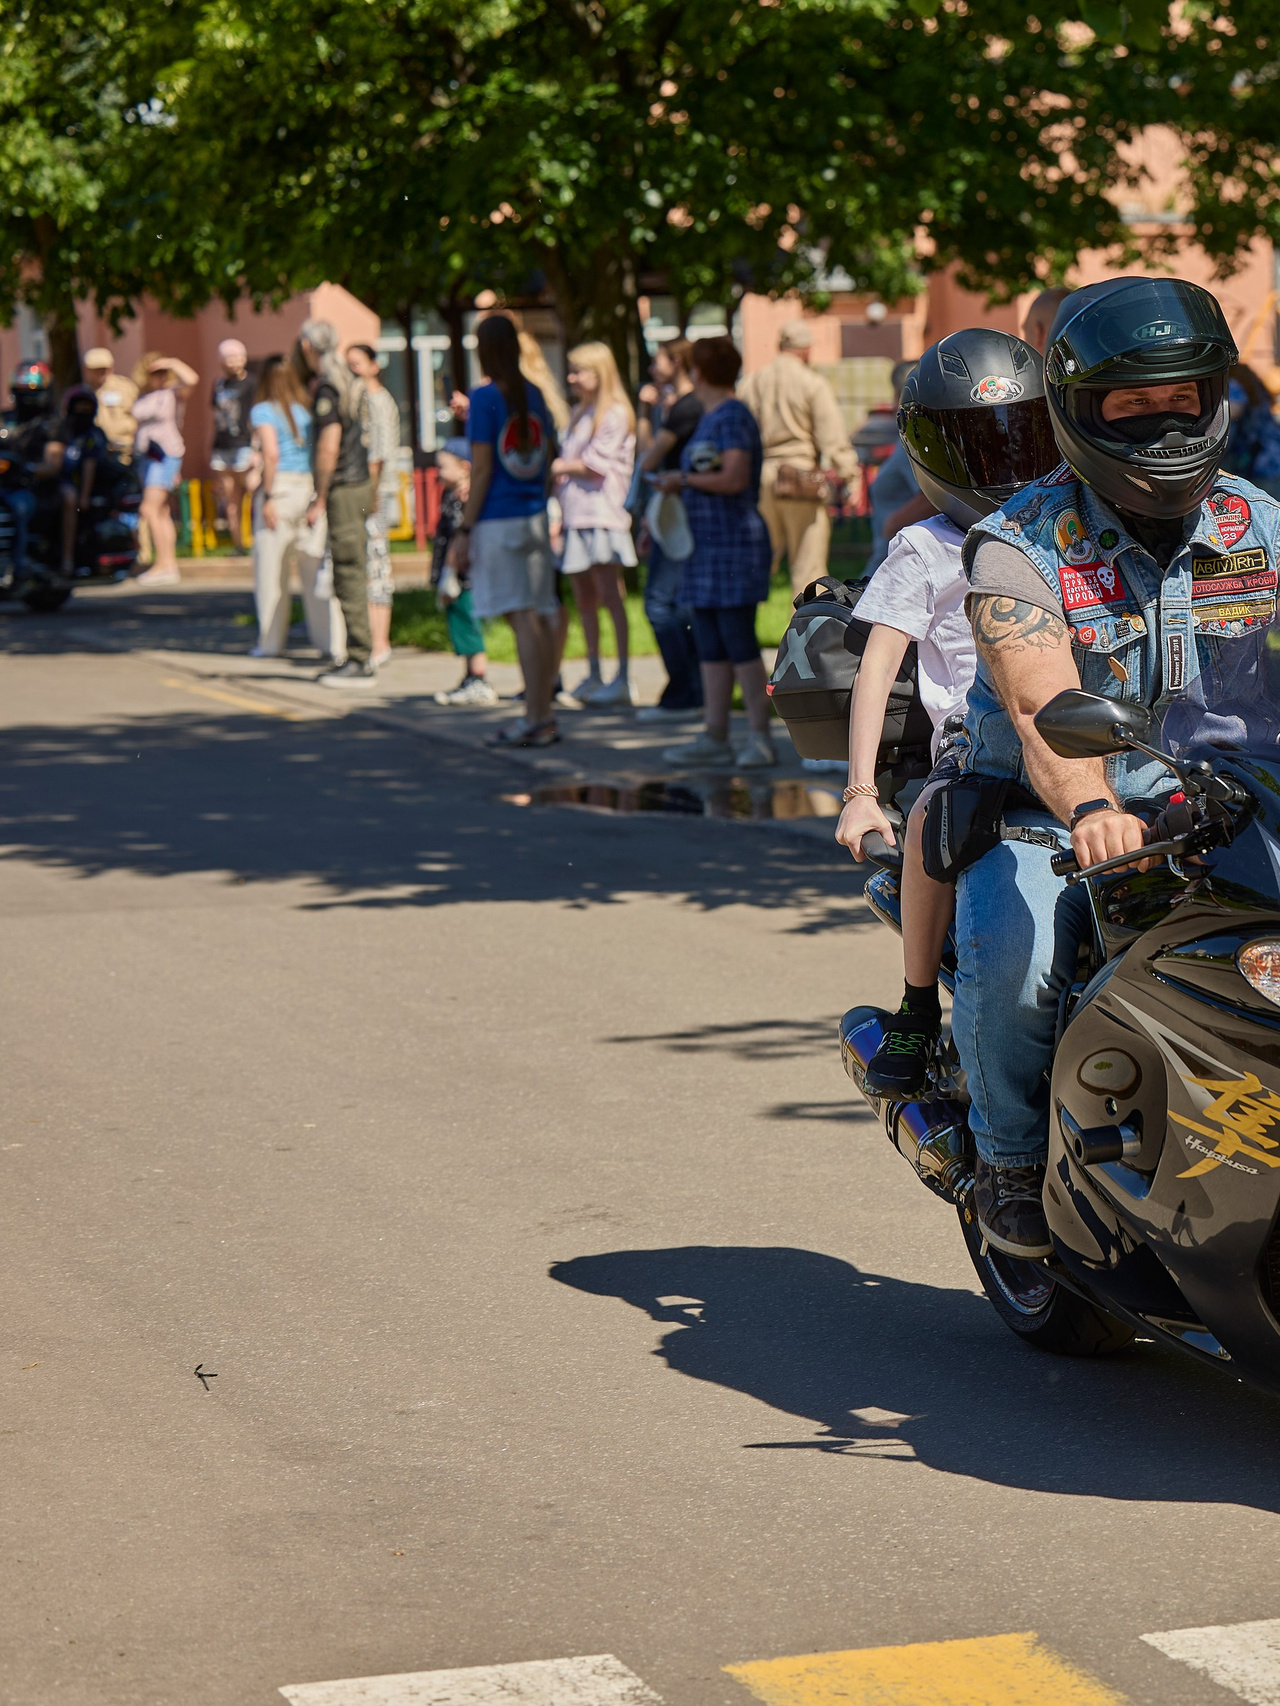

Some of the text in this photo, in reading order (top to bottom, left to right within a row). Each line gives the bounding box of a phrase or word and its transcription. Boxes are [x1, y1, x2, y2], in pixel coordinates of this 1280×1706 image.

[1247, 576, 1275, 587] КРОВИ
[1068, 589, 1104, 604] УРОДЫ
[1218, 605, 1251, 616] ВАДИК
[1184, 1134, 1260, 1175] Hayabusa
